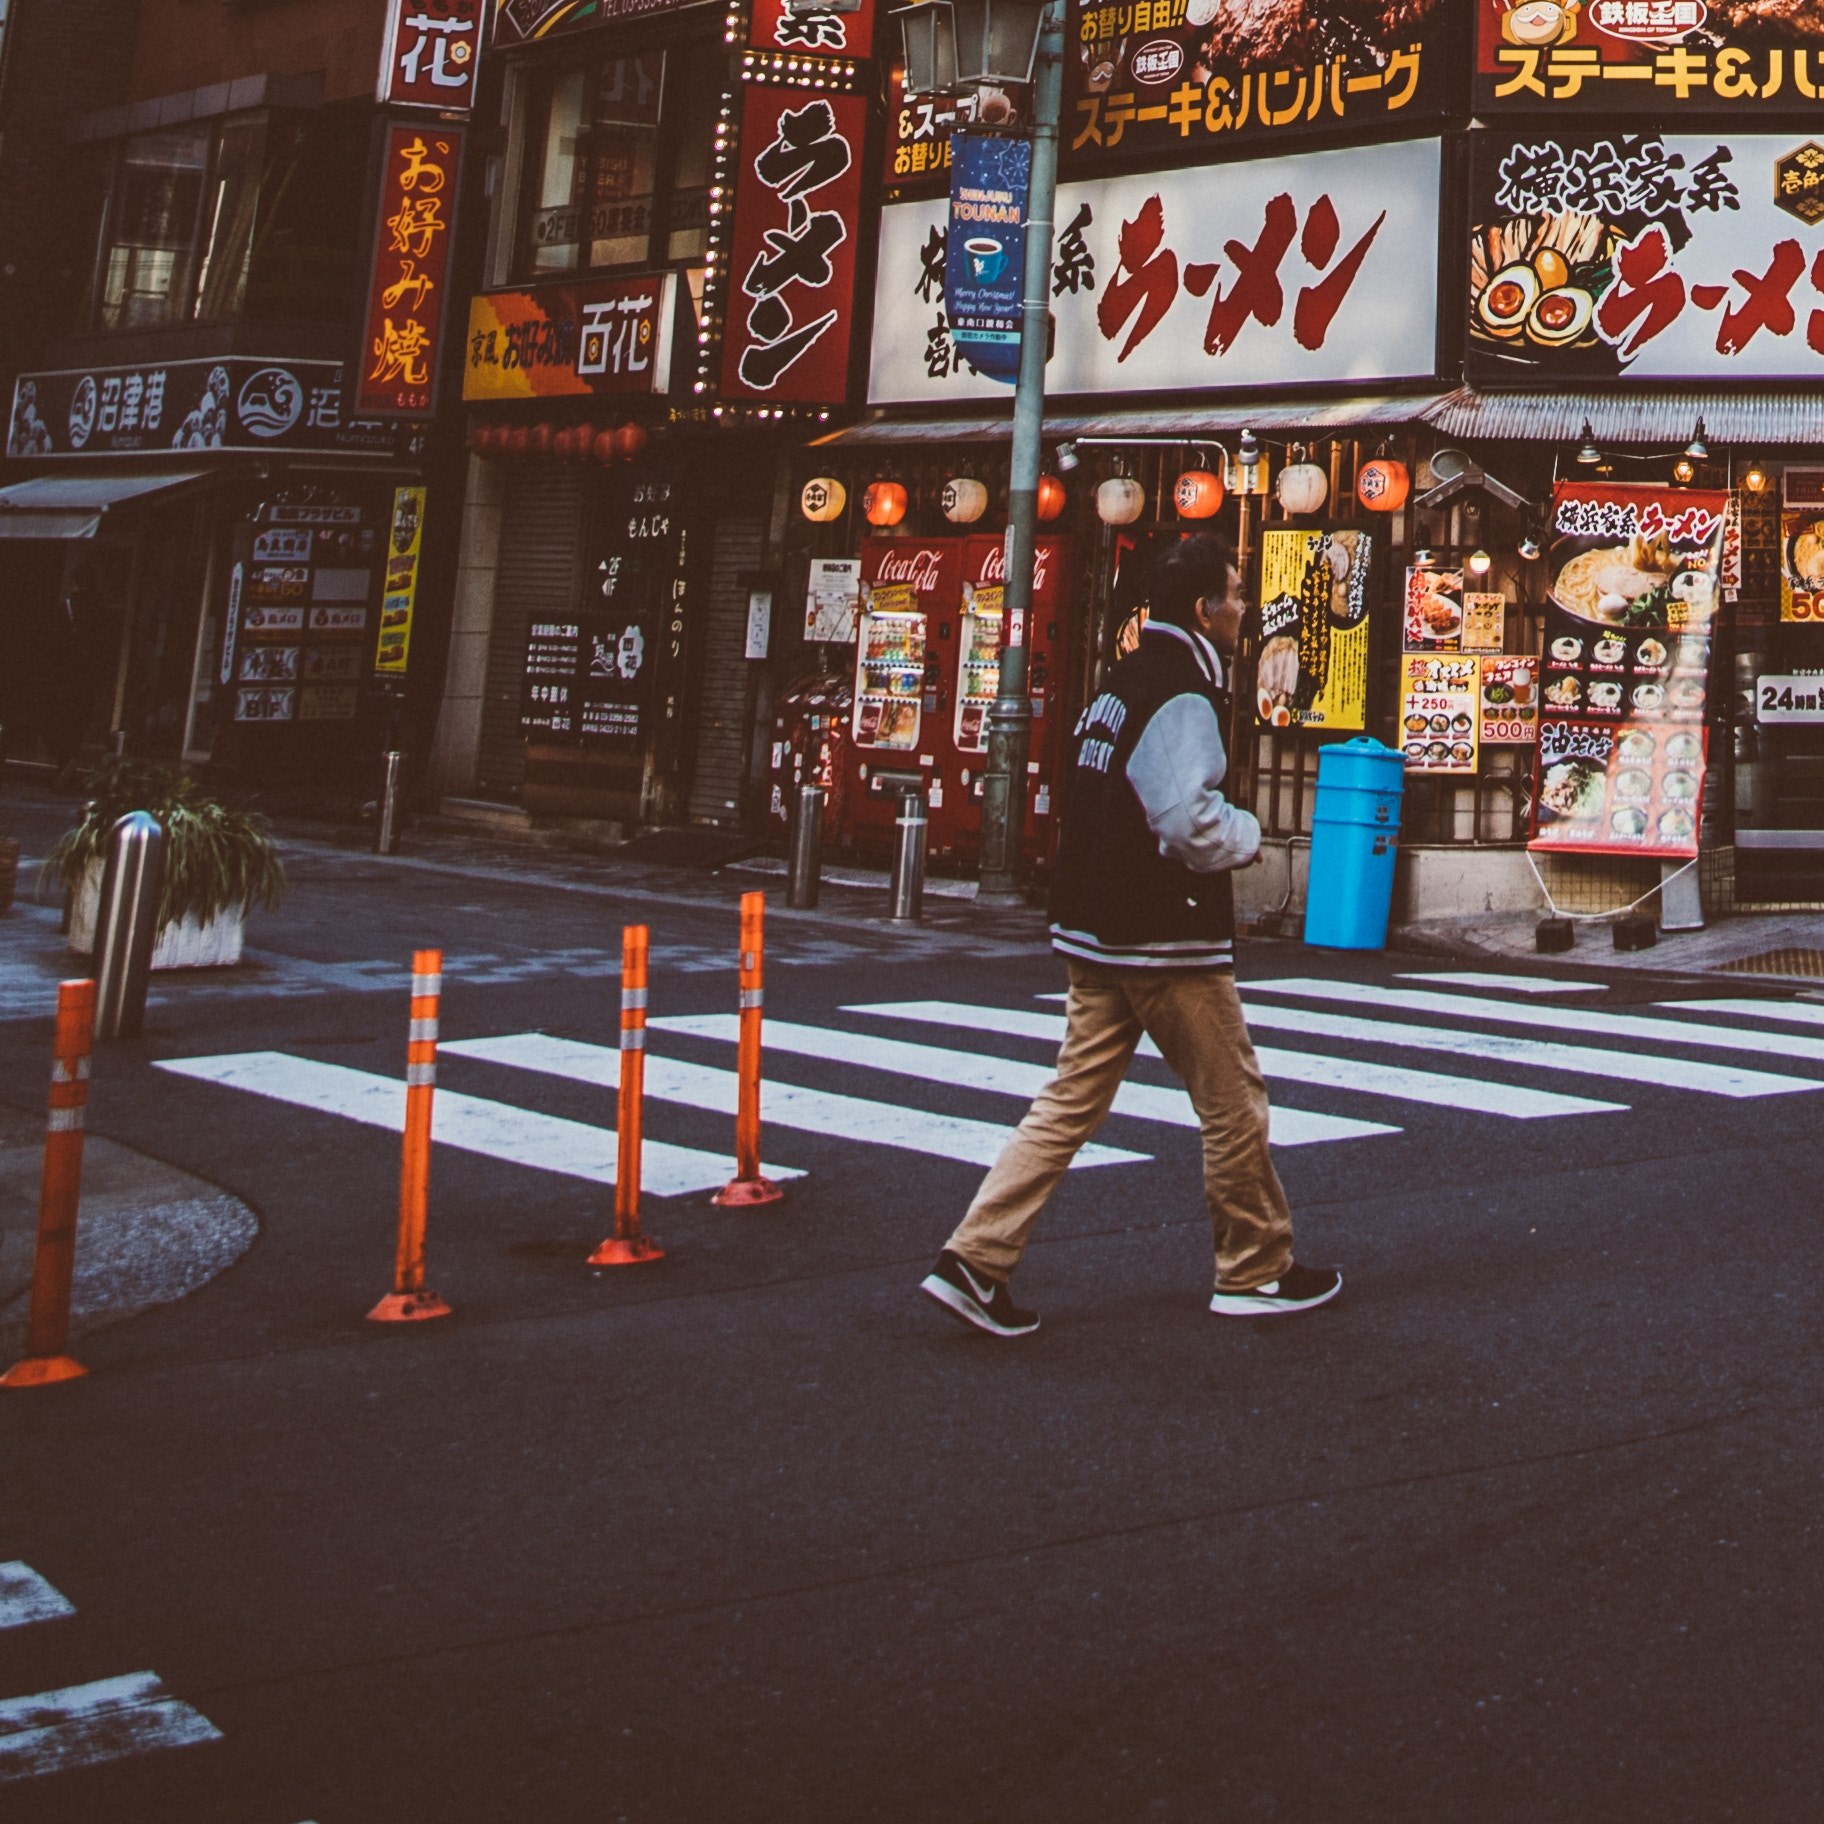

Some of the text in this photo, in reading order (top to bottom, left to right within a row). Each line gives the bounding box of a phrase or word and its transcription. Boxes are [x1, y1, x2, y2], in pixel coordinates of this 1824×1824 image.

[1598, 0, 1698, 26] 鉄板王国
[1072, 42, 1423, 151] ステーキ&ハンバーグ
[1498, 140, 1741, 216] 横浜家系
[368, 136, 450, 385] お好み焼
[1097, 190, 1387, 364] ラーメン
[953, 287, 977, 301] Merry
[577, 293, 653, 375] 百花
[408, 435, 427, 454] 4F
[1556, 500, 1640, 537] 横浜家系
[1483, 722, 1535, 739] 500円
